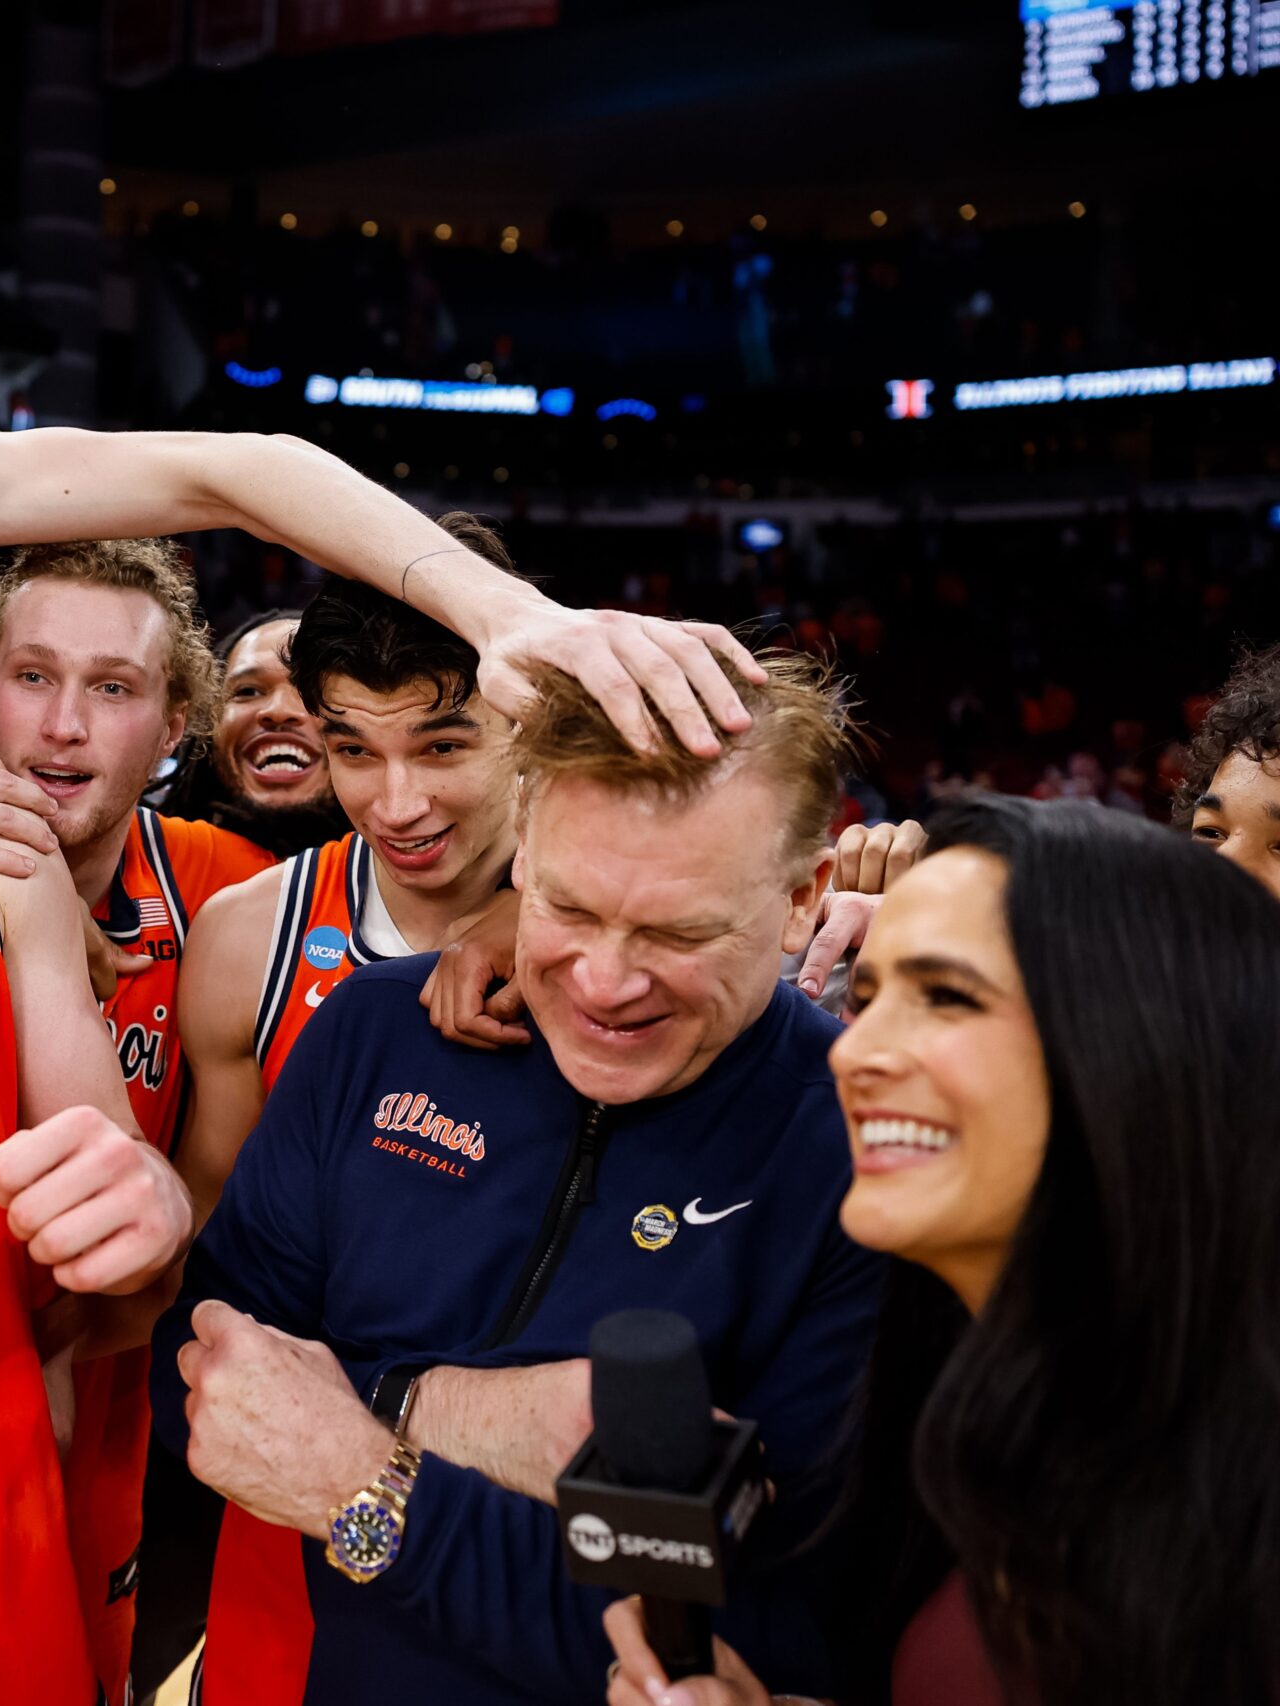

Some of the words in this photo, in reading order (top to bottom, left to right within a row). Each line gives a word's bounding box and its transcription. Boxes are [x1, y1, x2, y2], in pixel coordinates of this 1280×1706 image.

[308, 944, 344, 960] NCAA
[373, 1092, 485, 1161] Illinois
[372, 1136, 466, 1178] BASKETBALL
[618, 1533, 715, 1568] SPORTS
